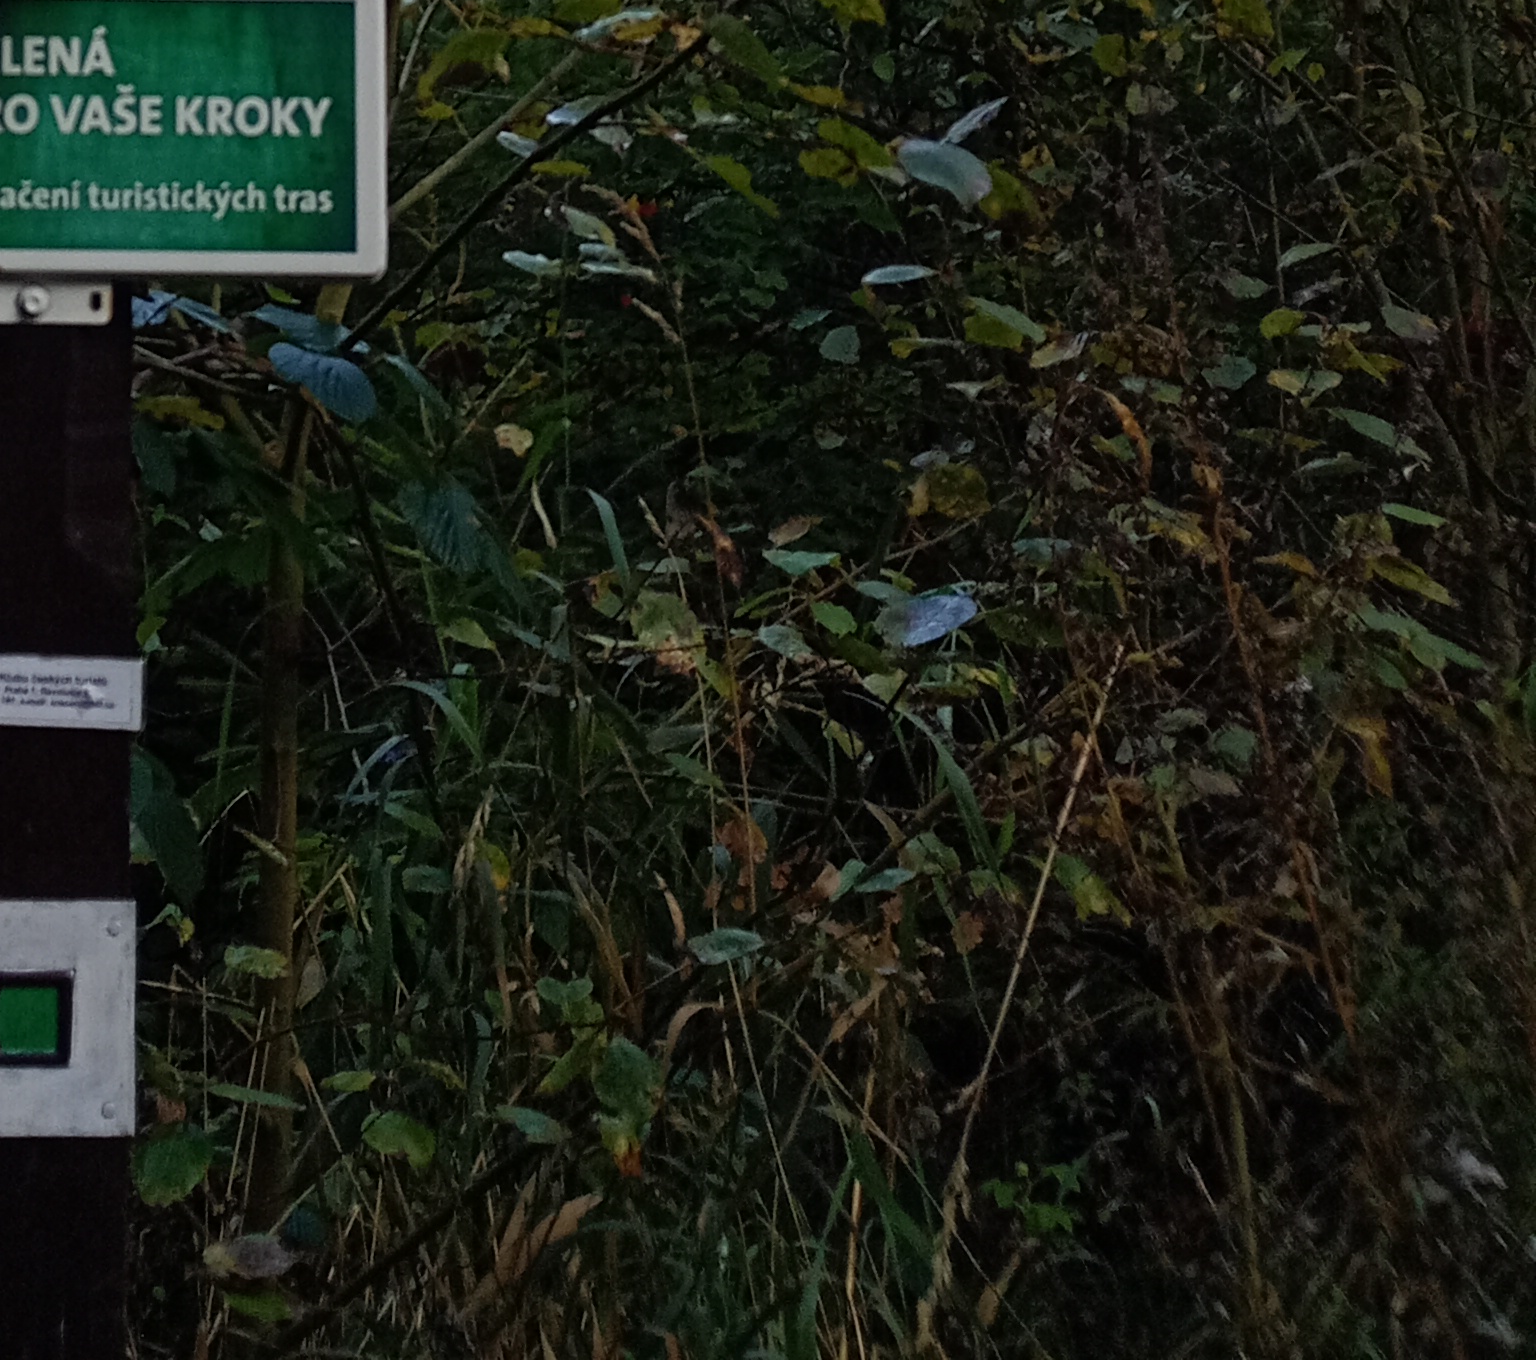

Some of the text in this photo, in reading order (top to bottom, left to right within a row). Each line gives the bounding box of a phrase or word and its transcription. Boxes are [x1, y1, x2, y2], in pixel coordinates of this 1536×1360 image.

[49, 83, 163, 136] VAŠE
[175, 95, 332, 139] KROKY
[87, 180, 267, 221] turistických
[273, 183, 334, 214] tras
